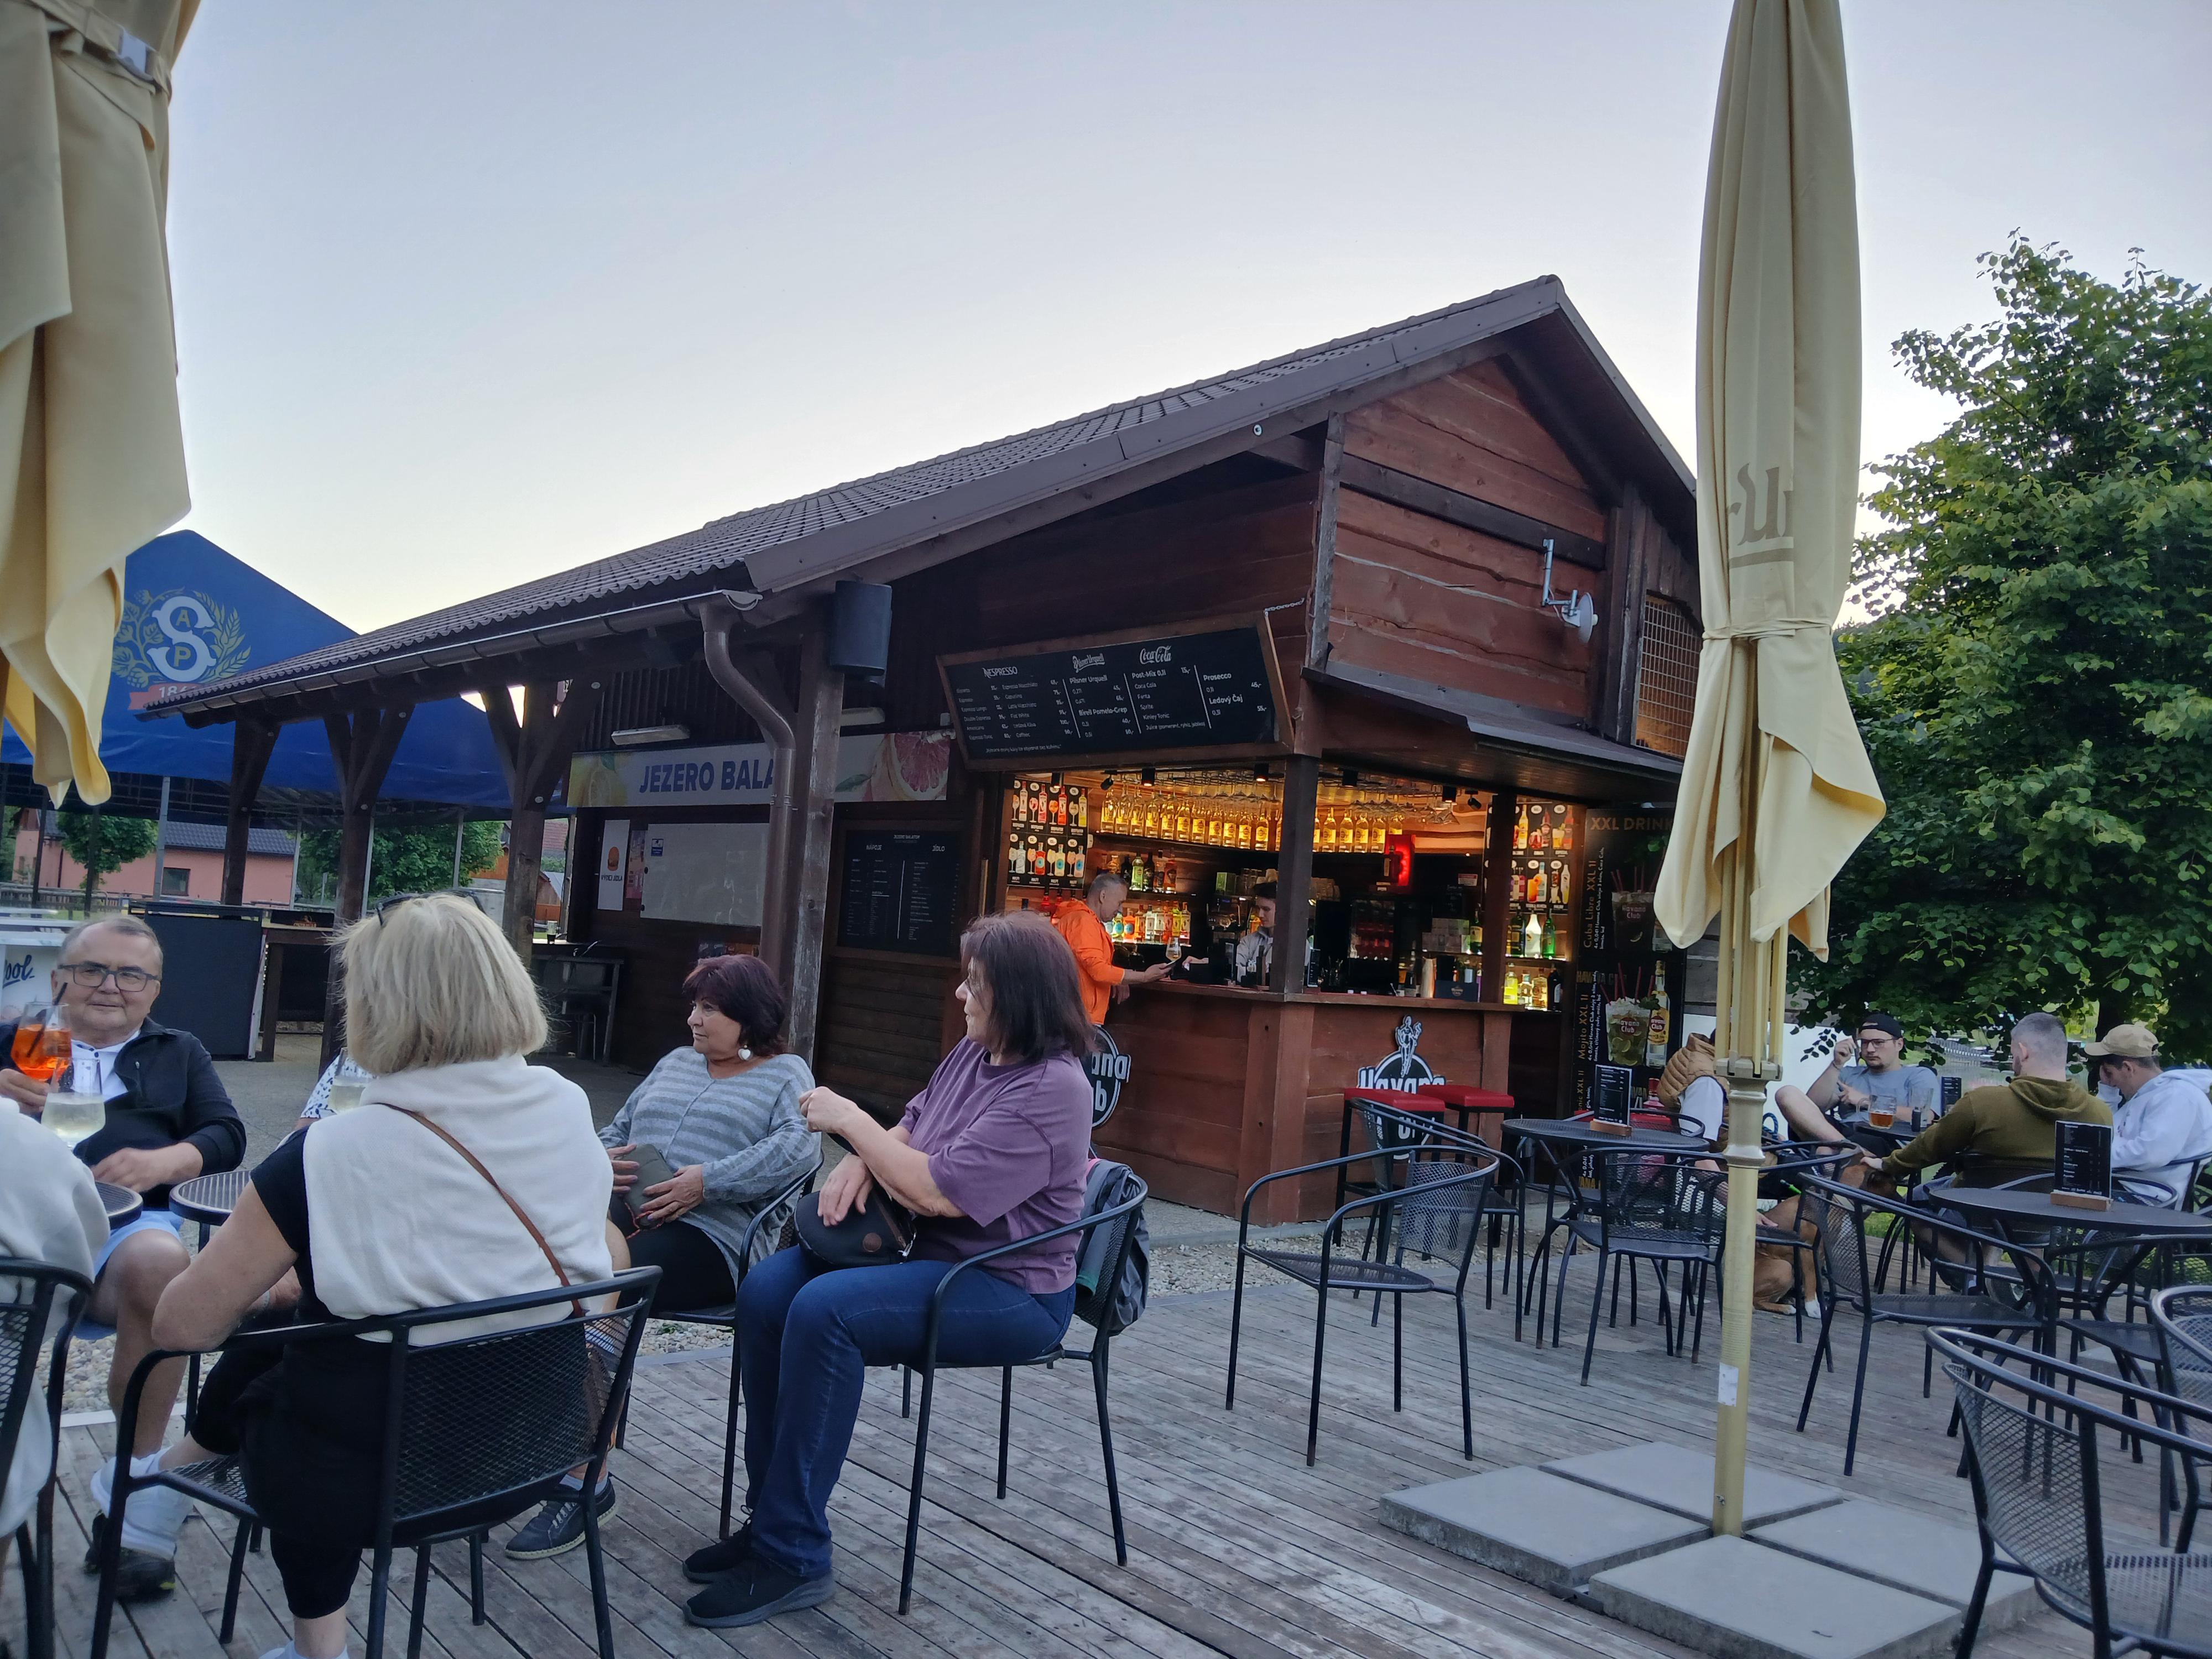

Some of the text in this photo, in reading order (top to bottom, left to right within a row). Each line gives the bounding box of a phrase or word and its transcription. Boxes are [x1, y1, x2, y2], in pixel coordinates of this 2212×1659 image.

[175, 609, 191, 628] A
[174, 645, 191, 667] P
[982, 666, 1018, 679] NESPRESSO
[1088, 675, 1108, 684] Urquell
[1132, 670, 1156, 679] Post-Mix
[1209, 693, 1243, 705] Ledový Čaj
[639, 758, 774, 793] JEZERO BALA
[1590, 817, 1673, 830] XXL DRINK
[1586, 870, 1596, 891] XXL
[1583, 924, 1593, 948] Cuba
[4, 954, 34, 981] ool
[1579, 1005, 1588, 1025] XXL
[1578, 1029, 1588, 1060] Mojito
[1092, 1053, 1128, 1079] ana
